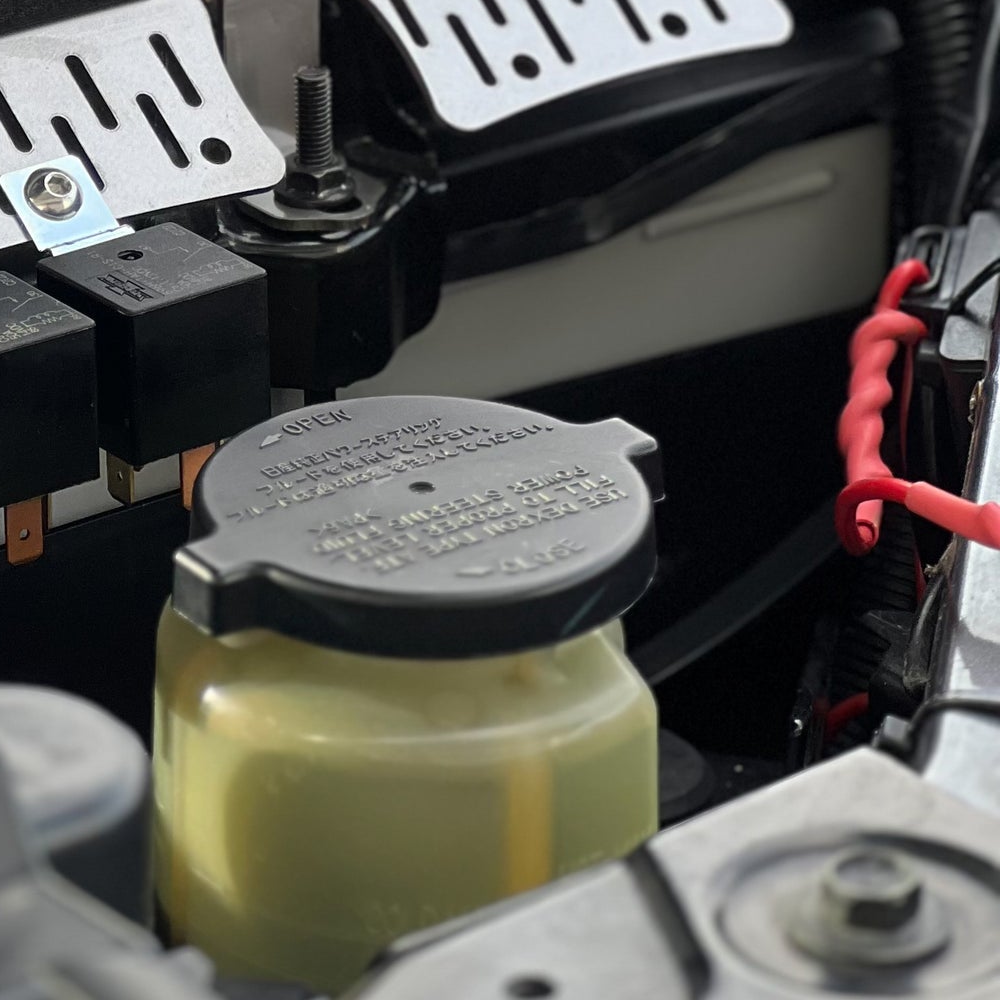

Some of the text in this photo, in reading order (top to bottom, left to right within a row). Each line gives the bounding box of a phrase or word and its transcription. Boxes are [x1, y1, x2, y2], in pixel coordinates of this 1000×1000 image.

[282, 409, 352, 434] OPEN
[556, 473, 616, 495] FILL
[312, 464, 590, 555] POWER STEERING FLUID
[523, 492, 555, 509] TO
[585, 488, 630, 511] USE
[422, 501, 515, 538] PROPER
[483, 499, 579, 538] DEXRON
[425, 533, 481, 558] TYPE
[500, 539, 585, 574] CLOSE
